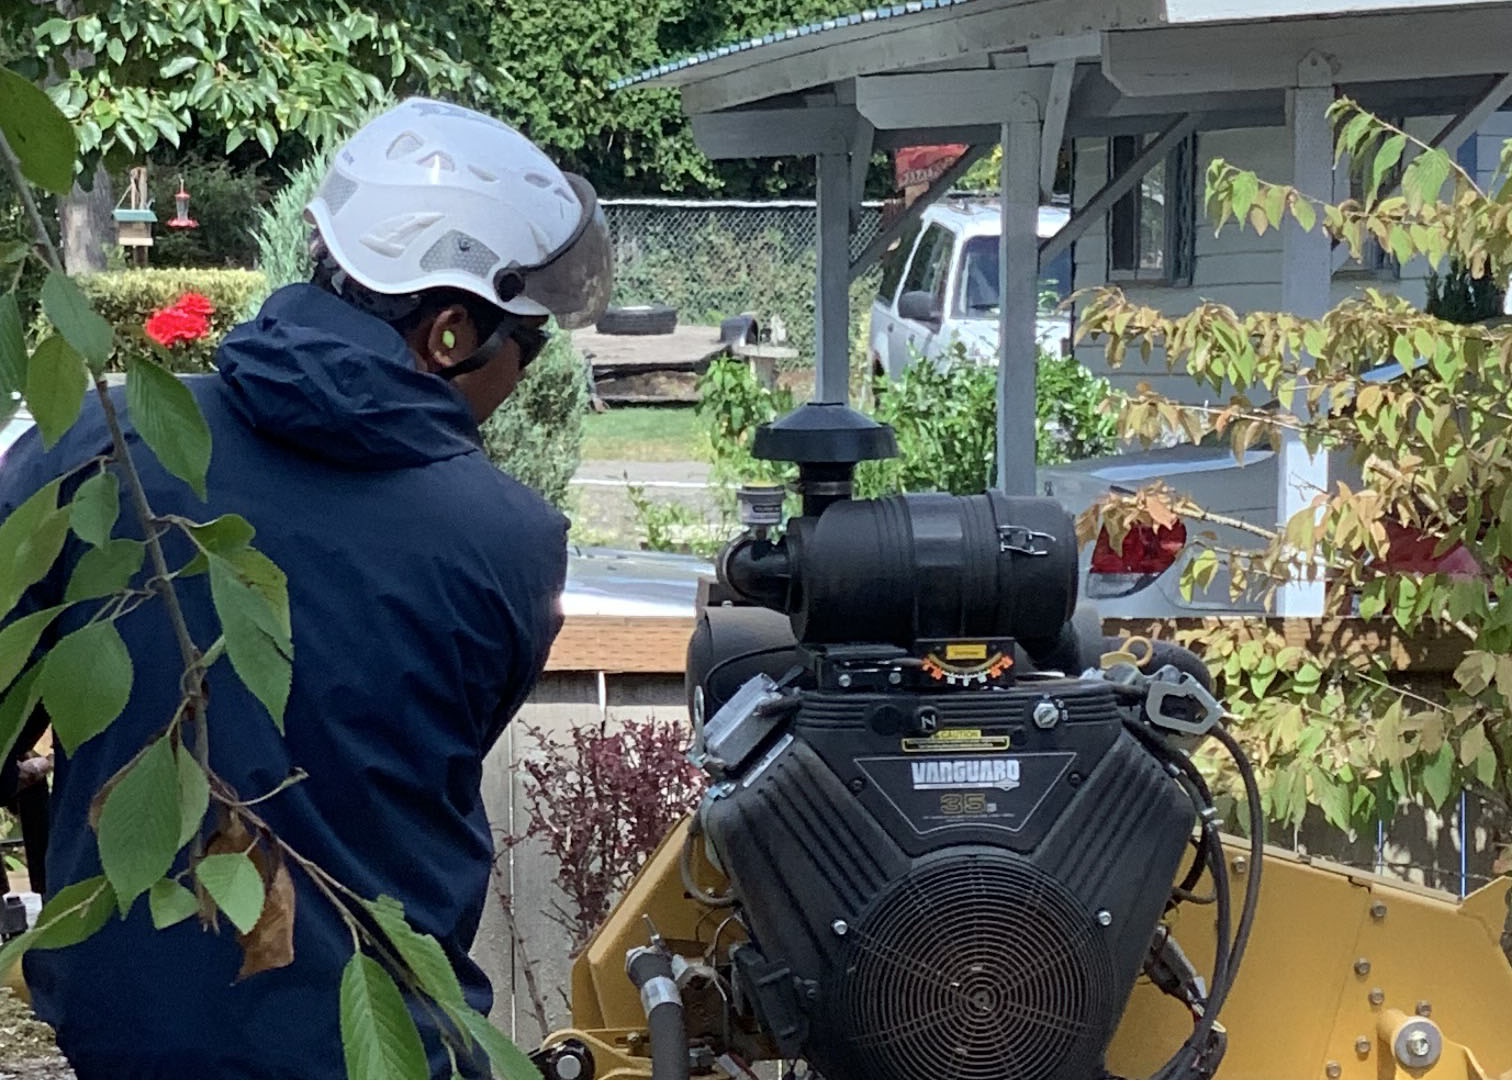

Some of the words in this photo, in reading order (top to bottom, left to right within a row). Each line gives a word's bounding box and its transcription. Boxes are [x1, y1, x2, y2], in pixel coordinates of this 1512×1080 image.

[940, 731, 978, 739] CAUTION
[911, 759, 1020, 784] VANGUARD
[940, 793, 986, 815] 35
